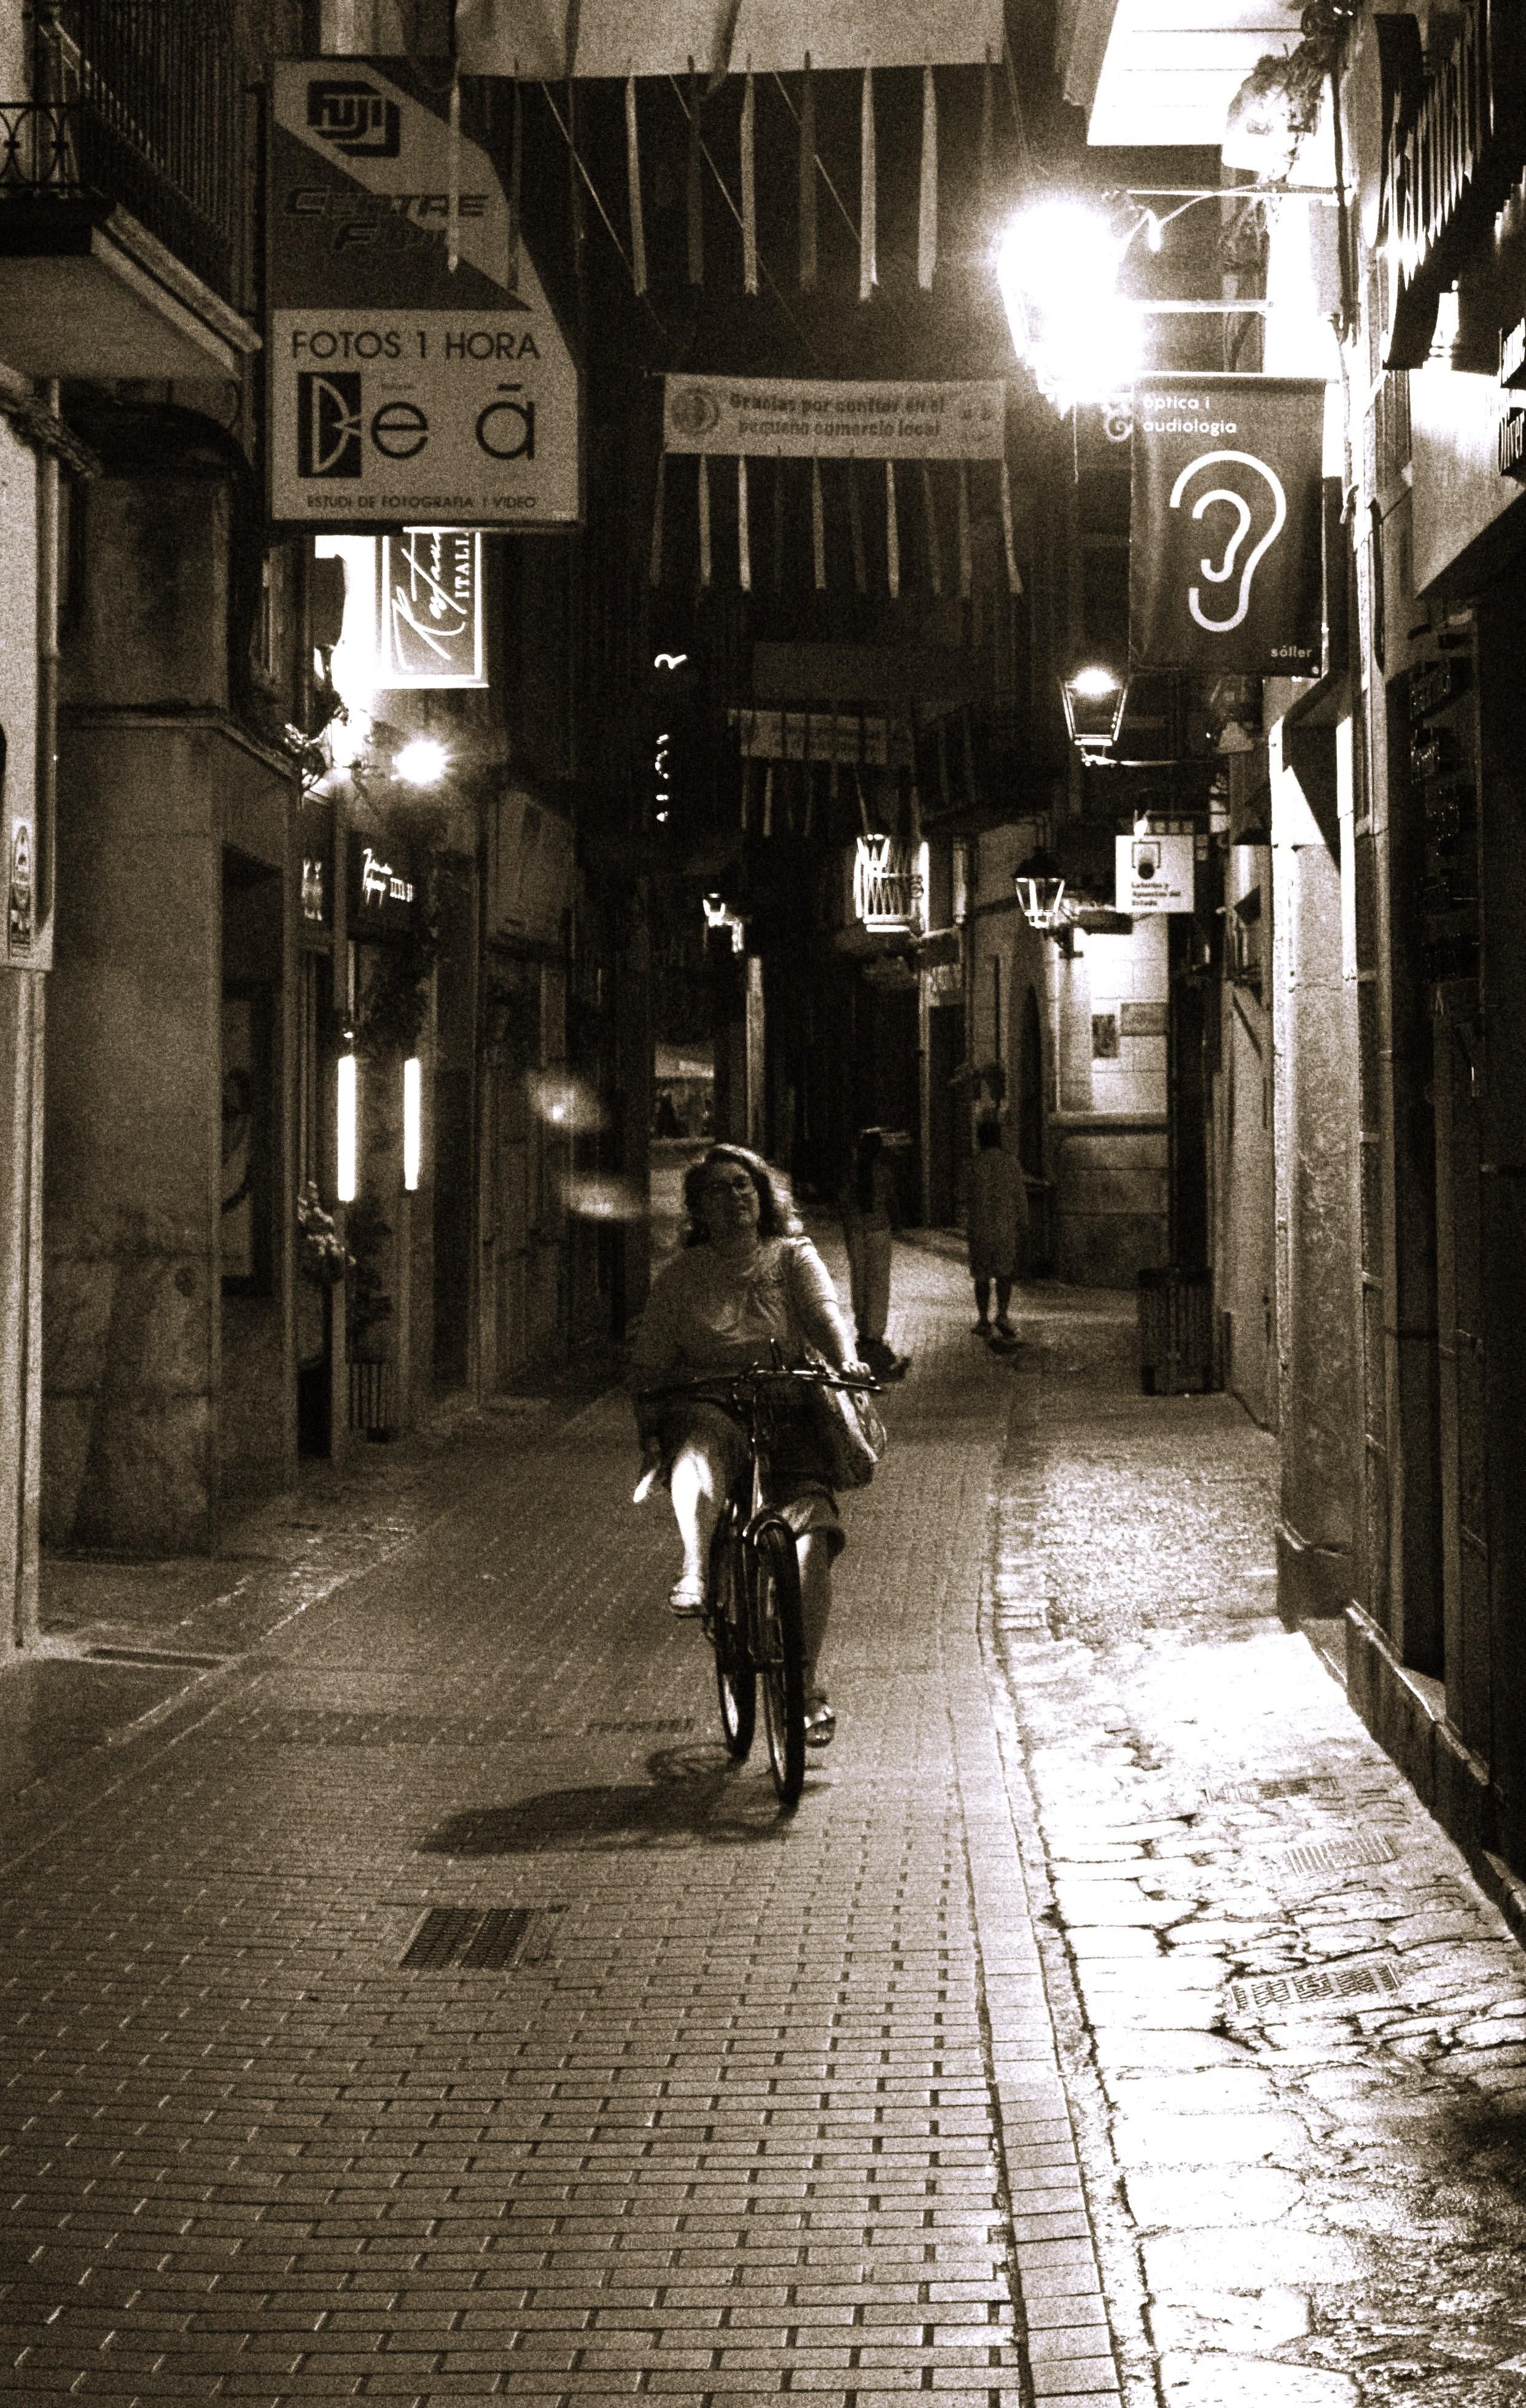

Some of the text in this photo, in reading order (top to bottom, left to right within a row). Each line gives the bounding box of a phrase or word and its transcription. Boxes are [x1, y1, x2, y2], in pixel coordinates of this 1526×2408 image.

[291, 332, 401, 359] FOTOS
[446, 332, 541, 360] HORA
[1143, 419, 1237, 437] audiologia
[454, 532, 470, 598] ITALI
